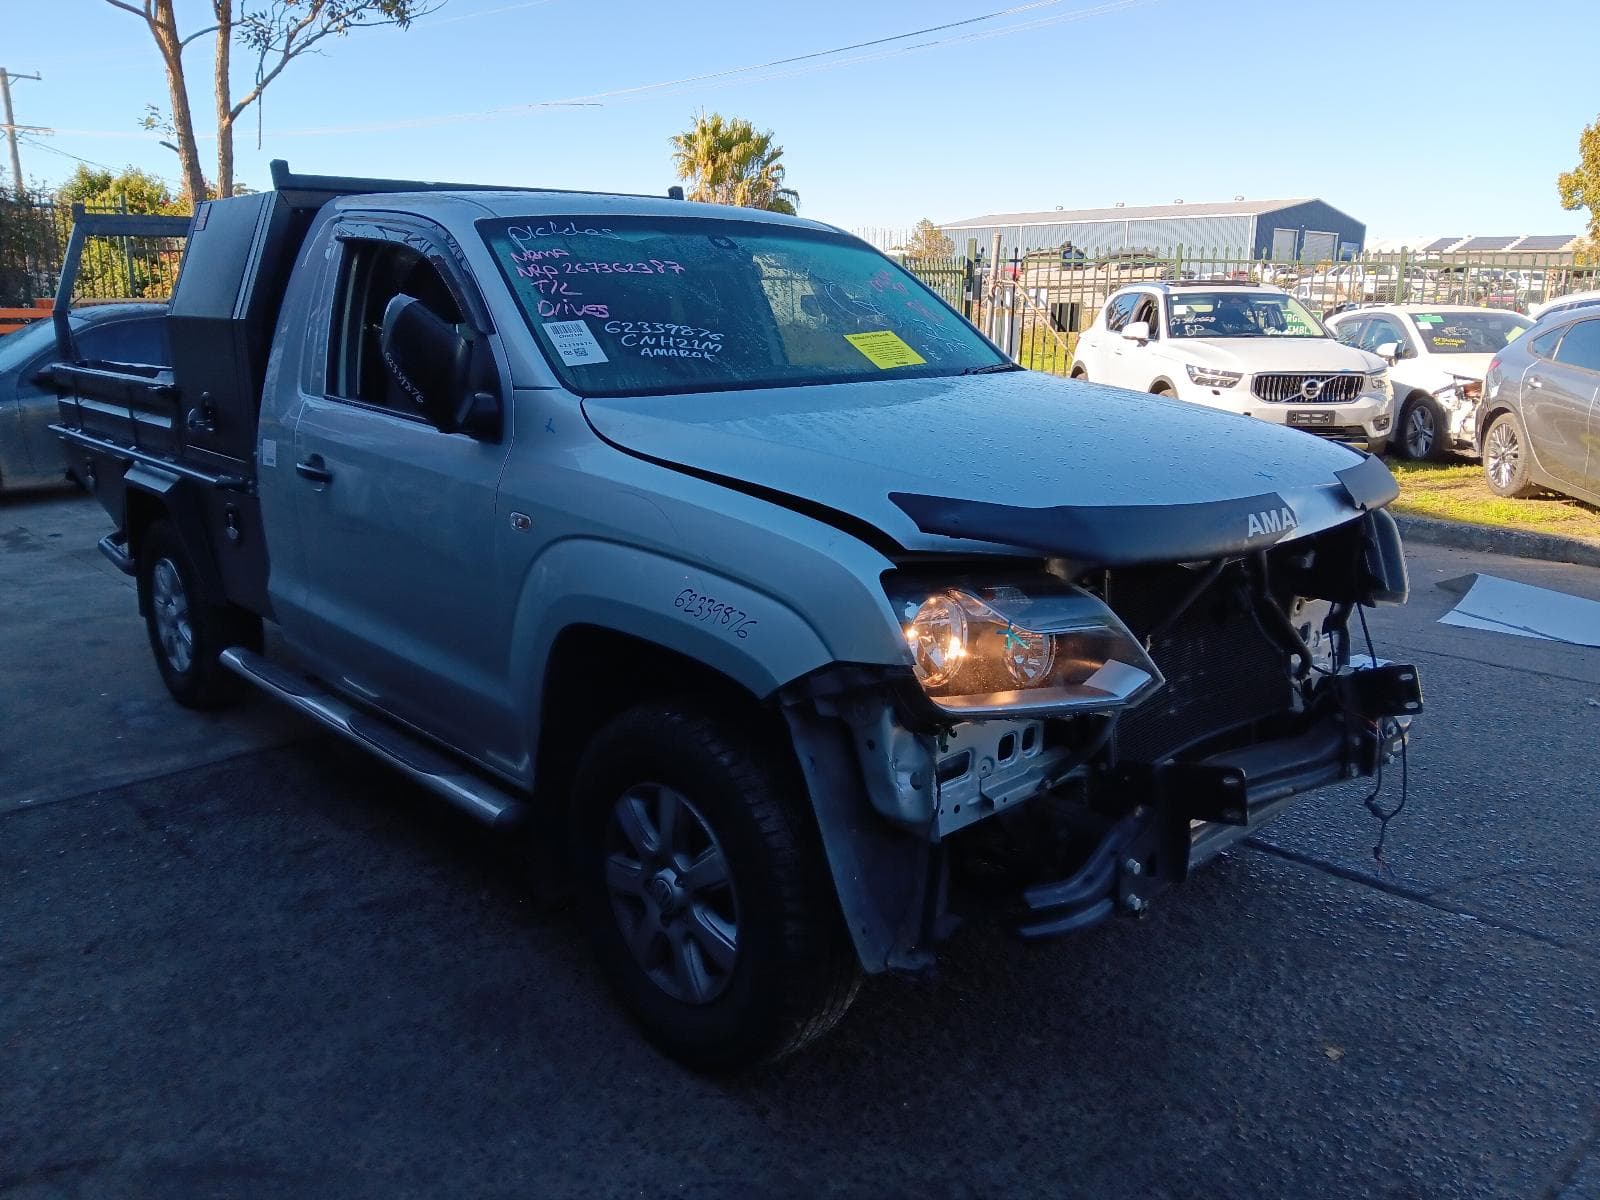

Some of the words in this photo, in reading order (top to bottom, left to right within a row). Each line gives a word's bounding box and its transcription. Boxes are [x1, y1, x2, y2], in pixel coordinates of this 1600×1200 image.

[604, 320, 725, 341] 62339876
[640, 347, 715, 362] AMAROK
[1247, 507, 1297, 538] AMA
[674, 588, 758, 639] 62339876
